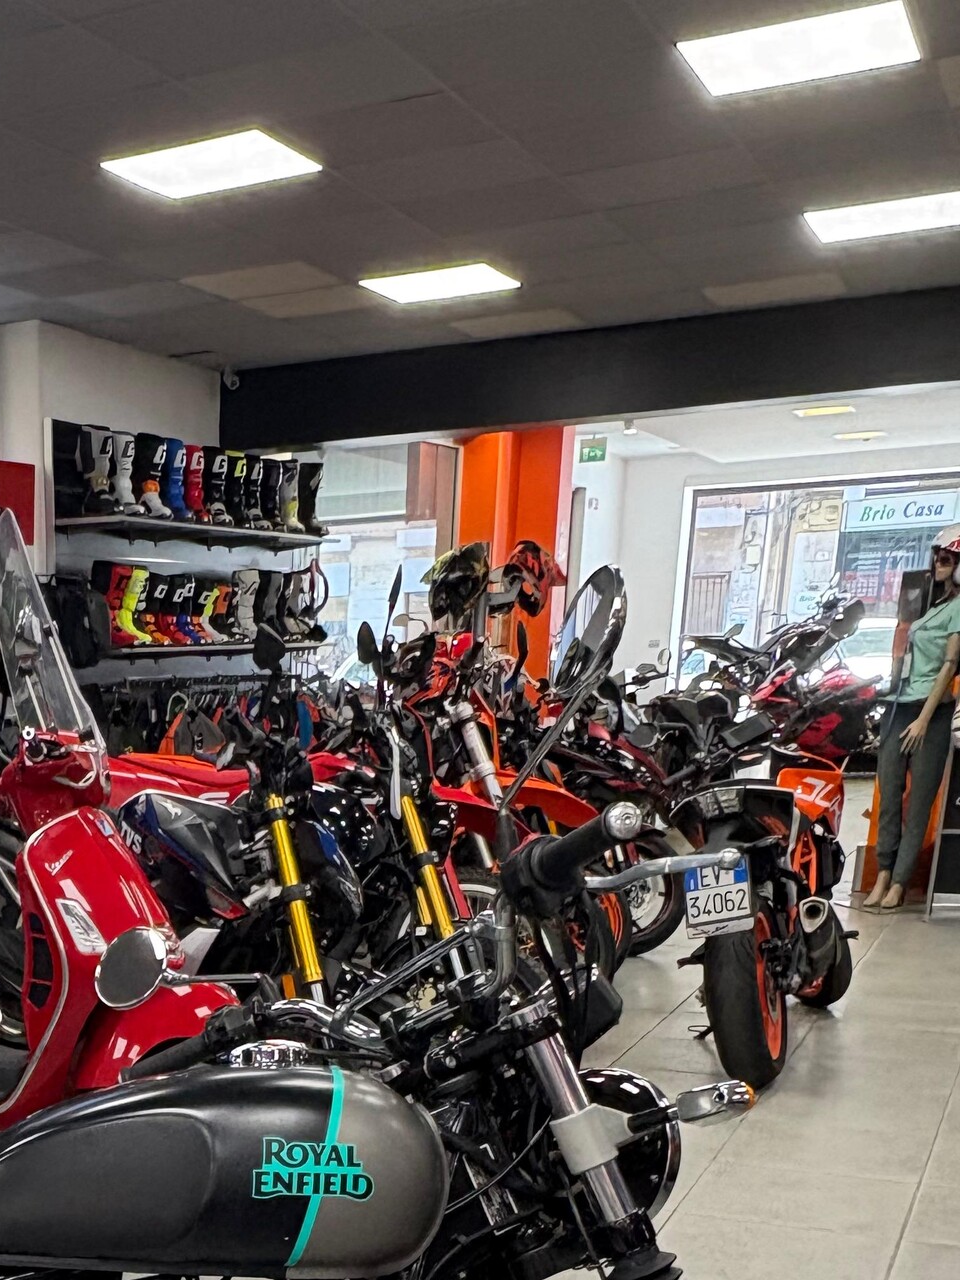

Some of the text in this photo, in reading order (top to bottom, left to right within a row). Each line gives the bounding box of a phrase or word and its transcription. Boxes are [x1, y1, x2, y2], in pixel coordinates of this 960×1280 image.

[859, 501, 945, 522] Brio Casa
[120, 820, 143, 855] TVS
[689, 888, 748, 919] 34062
[262, 1137, 362, 1168] ROYAL
[252, 1169, 374, 1201] ENFIELD
